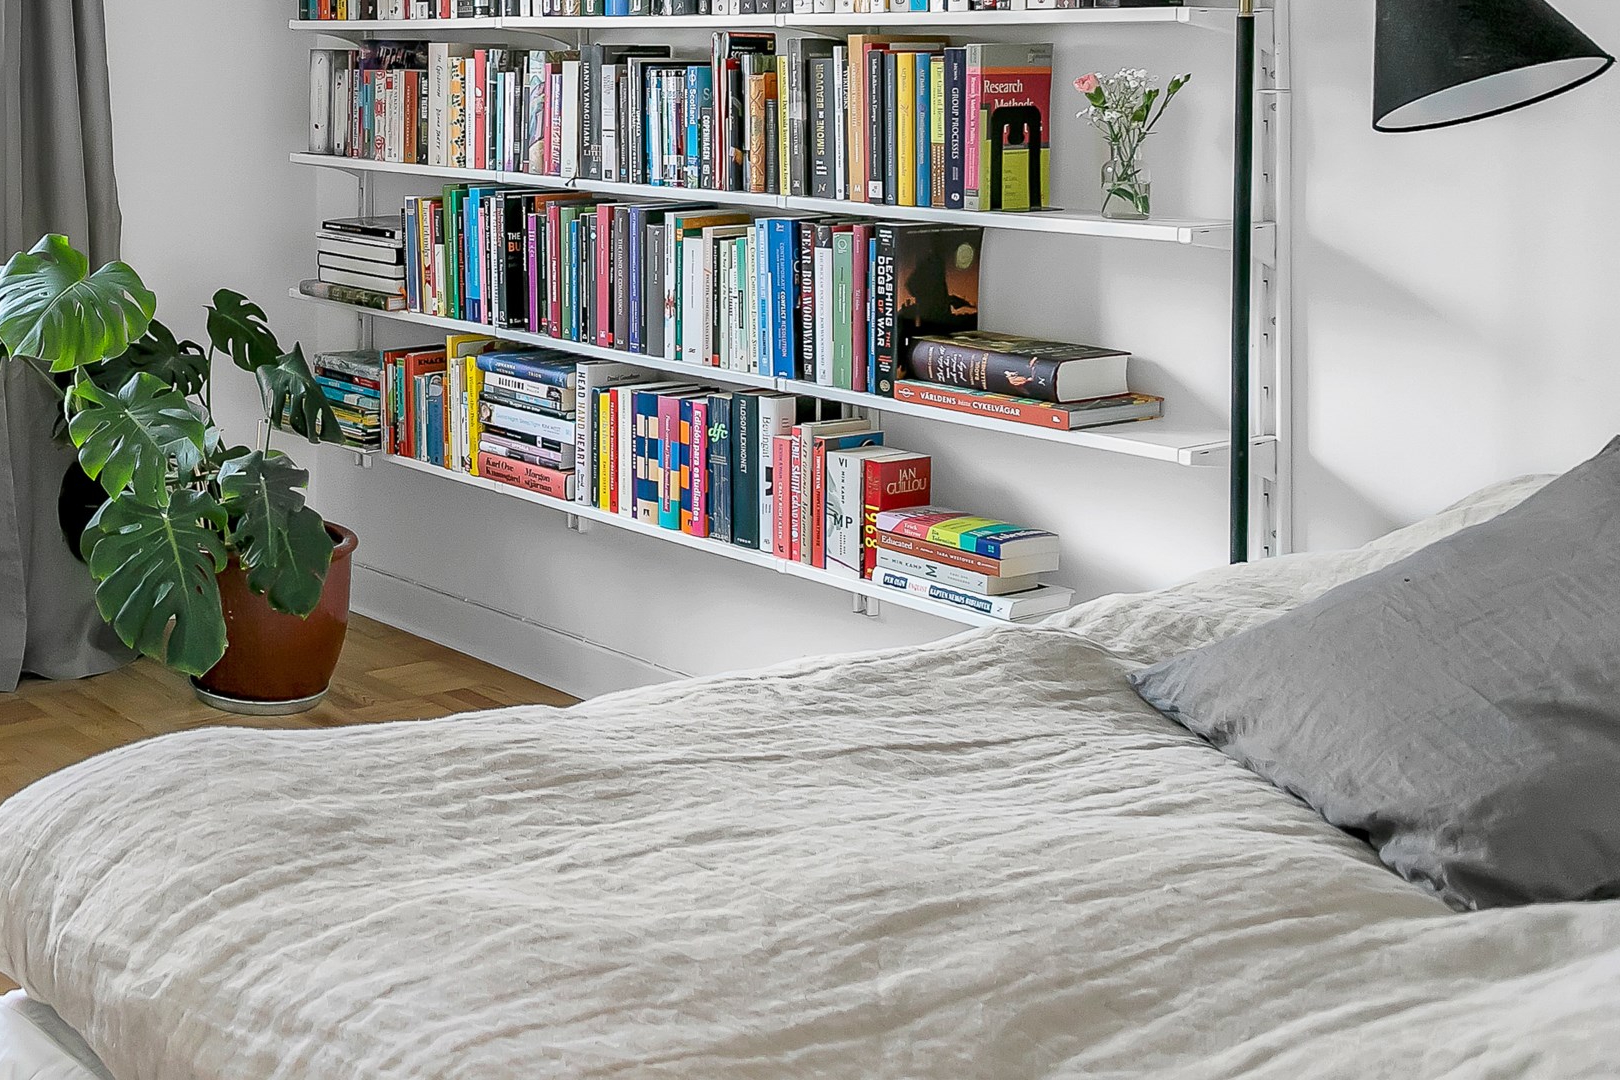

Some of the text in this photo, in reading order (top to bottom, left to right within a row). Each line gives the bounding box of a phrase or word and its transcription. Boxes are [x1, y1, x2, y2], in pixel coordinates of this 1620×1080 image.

[983, 79, 1024, 93] Research
[816, 63, 825, 155] SIMONE DE BEAUVOIR
[951, 87, 959, 116] GROUP
[702, 114, 711, 160] COPENHAGEN
[951, 116, 959, 159] PROCESSES
[618, 269, 623, 278] OF
[802, 230, 813, 360] FEAR BOB WOODWARD
[885, 256, 893, 327] LEASHING
[877, 255, 885, 347] DOGS OF WAR
[528, 371, 542, 379] TRION
[919, 392, 956, 405] VÄRLDENS
[971, 399, 1020, 416] CYKELVÄGAR
[577, 372, 586, 466] HEAD HAND HEART
[486, 457, 514, 472] Karl Ove
[693, 410, 702, 521] Edición para estudiantes
[838, 458, 848, 468] VI
[485, 467, 521, 484] Knausgård
[524, 468, 551, 483] Morgon
[898, 468, 917, 480] JAN
[524, 480, 552, 493] stjärnan
[791, 435, 800, 544] ZADIE SMITH GRAND UNION
[887, 479, 927, 495] GUILLOU
[833, 518, 853, 529] MP
[865, 505, 880, 549] 1968
[904, 522, 918, 530] Trick
[881, 535, 913, 550] Educated
[936, 550, 974, 564] TARA WESTOVER
[905, 562, 922, 570] KAMP
